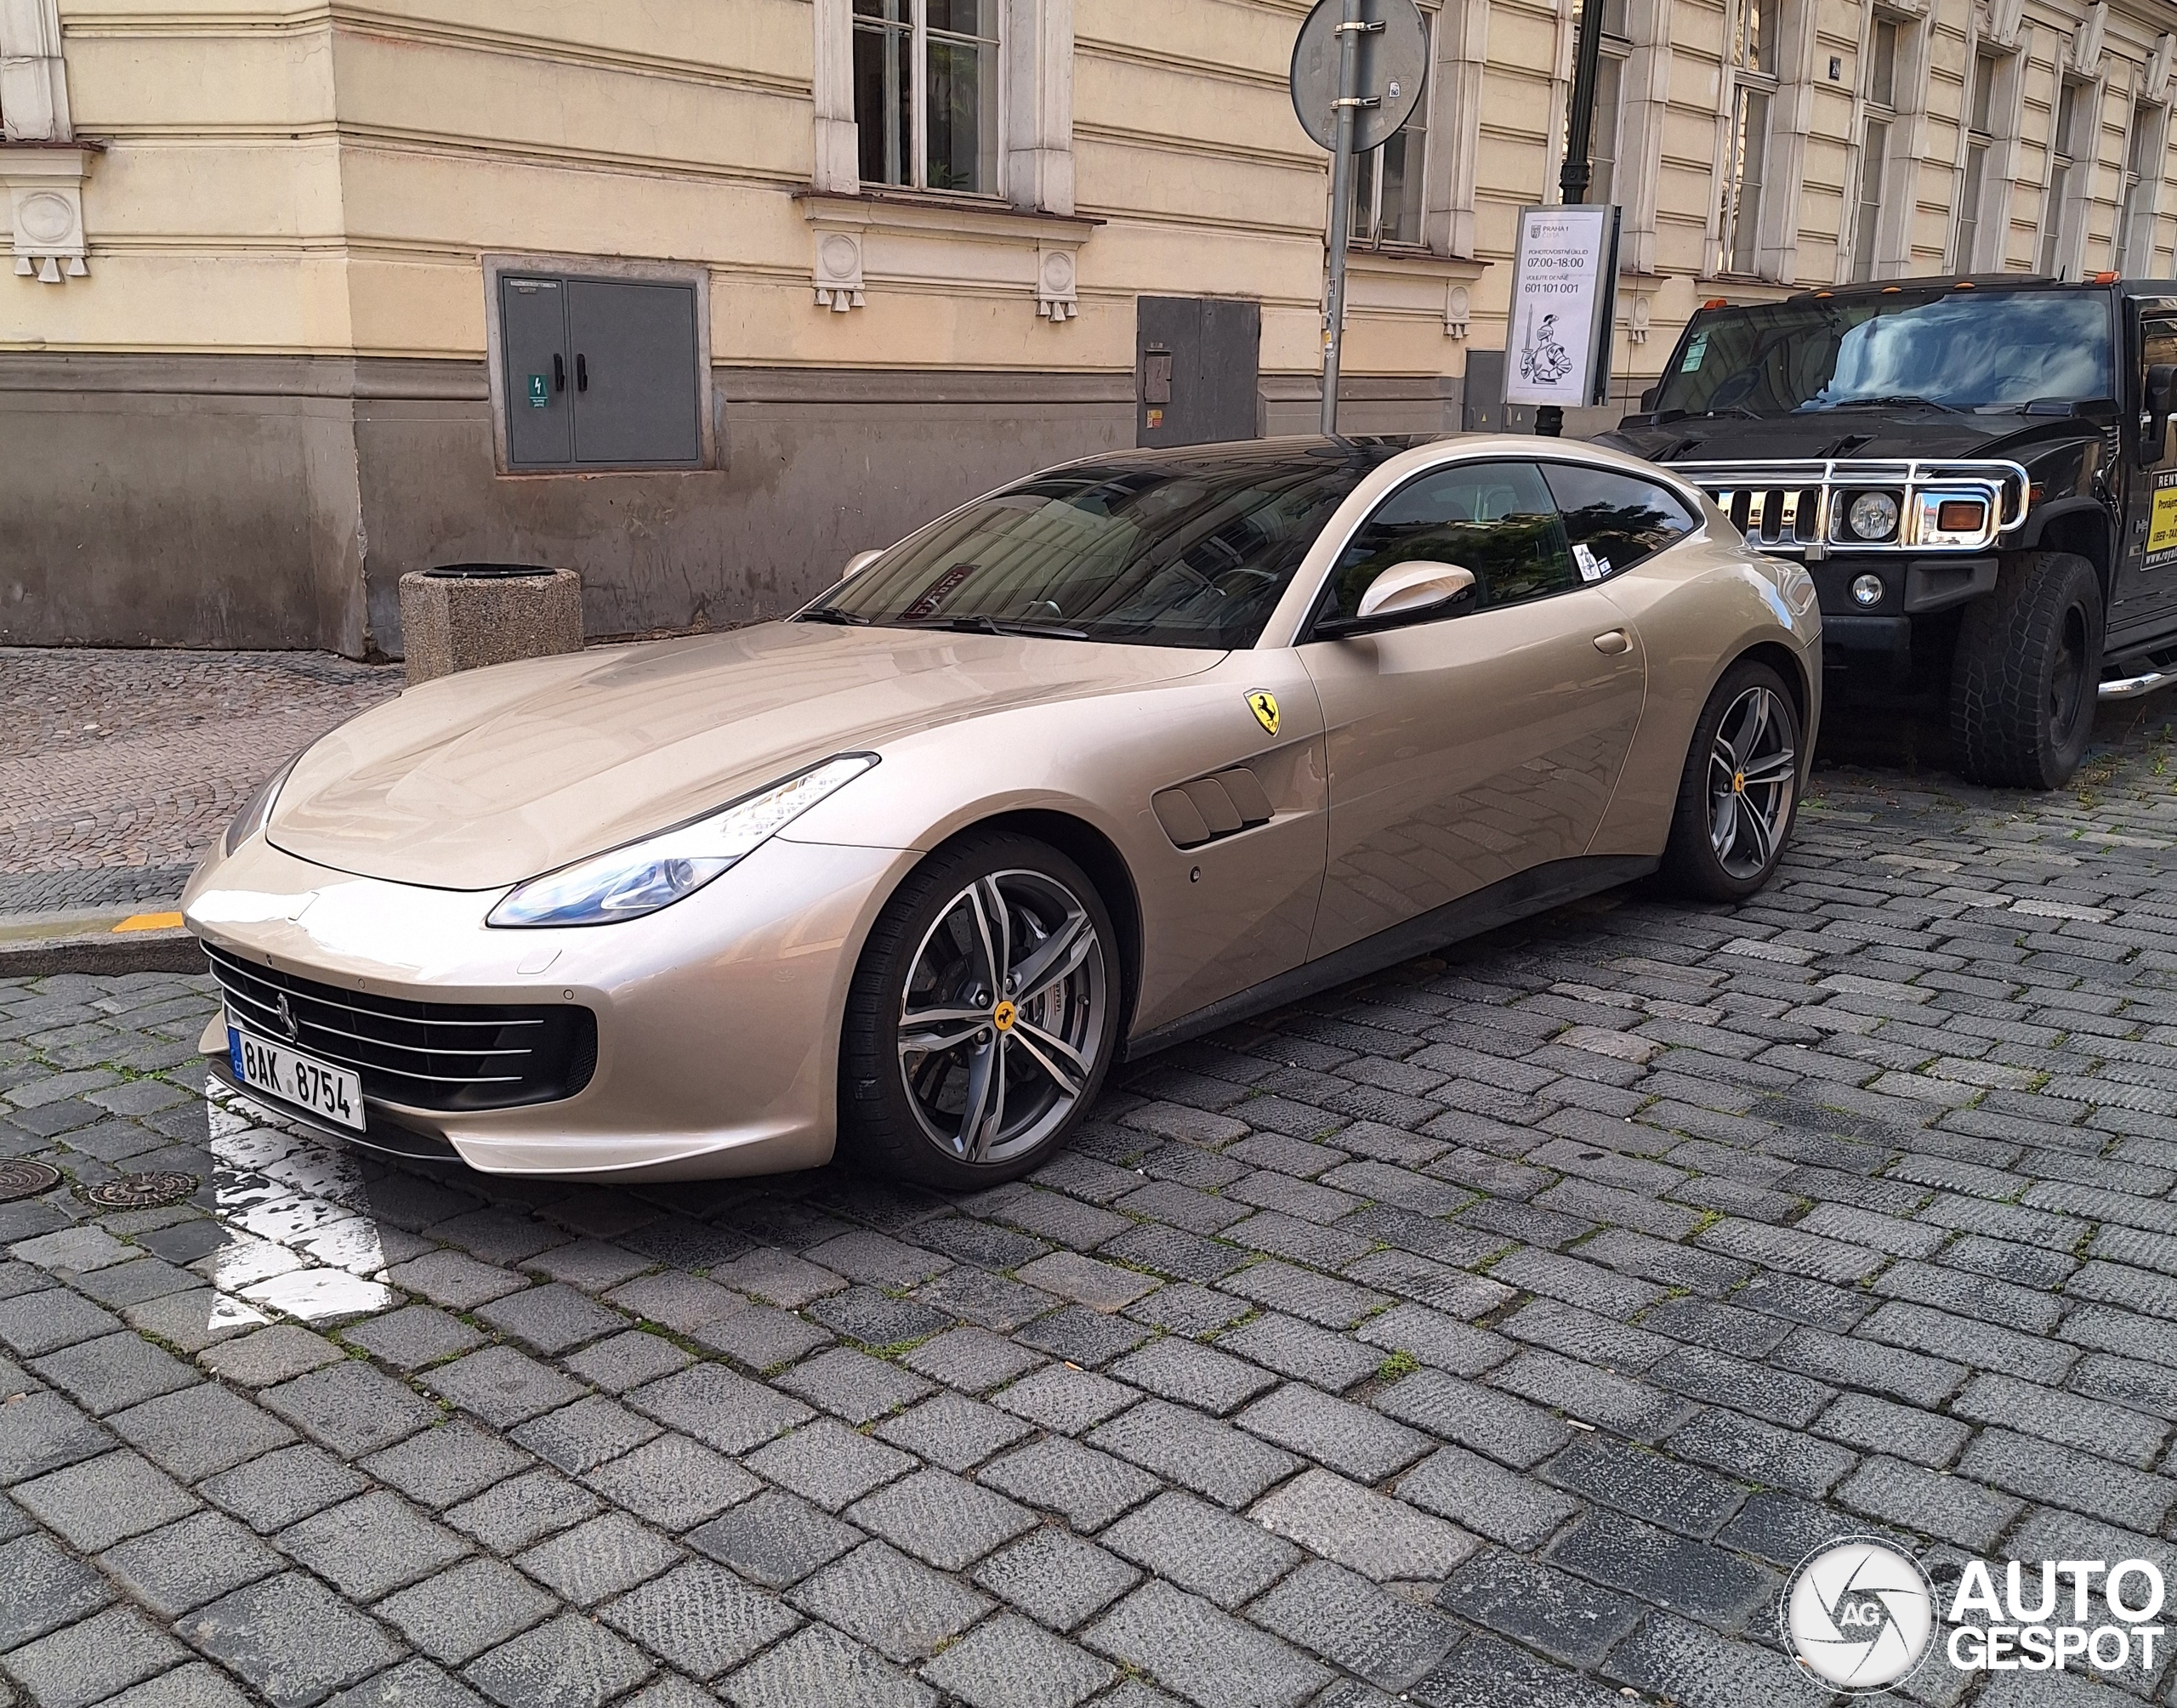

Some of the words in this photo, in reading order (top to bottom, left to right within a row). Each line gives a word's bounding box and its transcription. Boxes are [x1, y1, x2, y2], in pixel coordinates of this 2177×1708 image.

[1525, 283, 1541, 293] 601
[1542, 283, 1558, 293] 101
[1560, 283, 1579, 294] 001
[234, 1059, 244, 1074] CZ
[245, 1041, 283, 1092] 8AK
[295, 1061, 350, 1120] 8754
